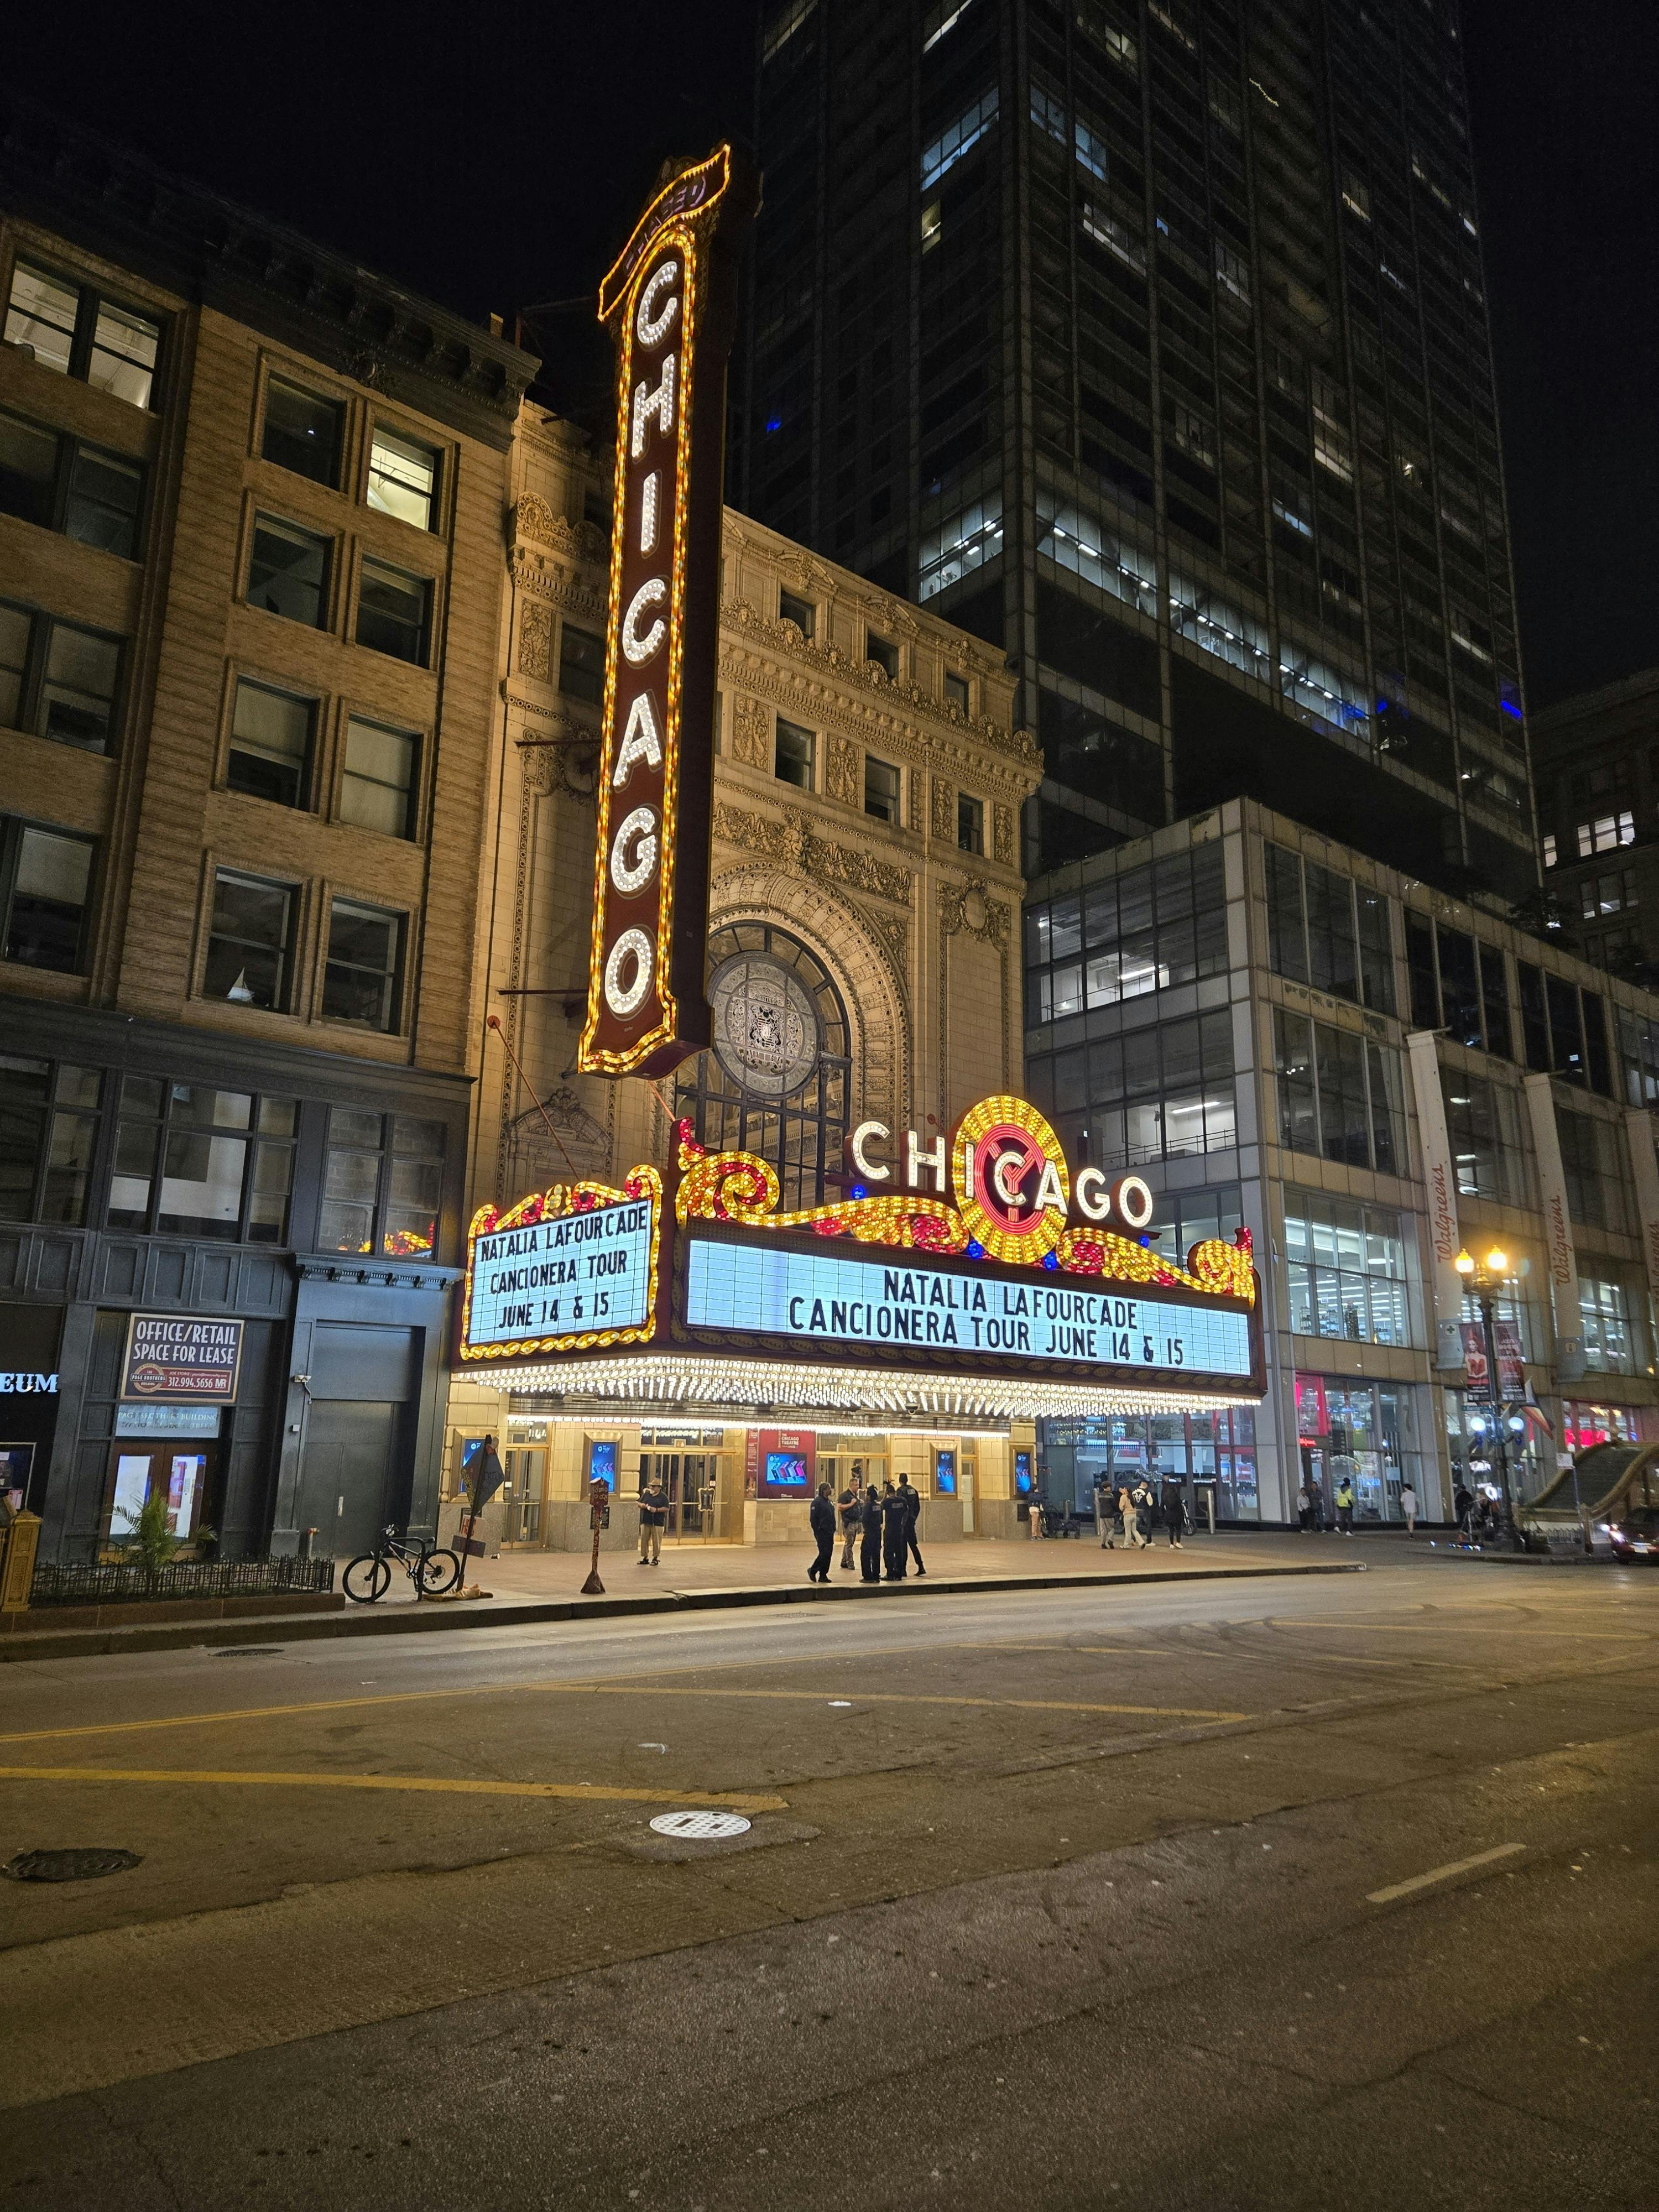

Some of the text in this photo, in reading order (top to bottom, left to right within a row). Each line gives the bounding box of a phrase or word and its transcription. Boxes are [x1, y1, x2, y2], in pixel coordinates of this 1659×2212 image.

[604, 261, 678, 1014] CHICAGO
[852, 1121, 1154, 1228] CHICAGO
[481, 1206, 648, 1262] NATALIA LAFOURCADE
[1432, 1163, 1455, 1264] Walgreens
[1550, 1194, 1573, 1287] Walgreens
[491, 1250, 627, 1294] CANCIONERA TOUR
[884, 1270, 1138, 1329] NATALIA LAFOURCADE
[136, 1321, 236, 1345] OFFICE/RETAIL
[499, 1291, 609, 1328] JUNE 14 & 15
[790, 1297, 1183, 1365] CANCIONERA TOUR JUNE 14 & 15
[133, 1343, 234, 1364] SPACE FOR LEASE
[168, 1377, 213, 1388] 312.994.5656
